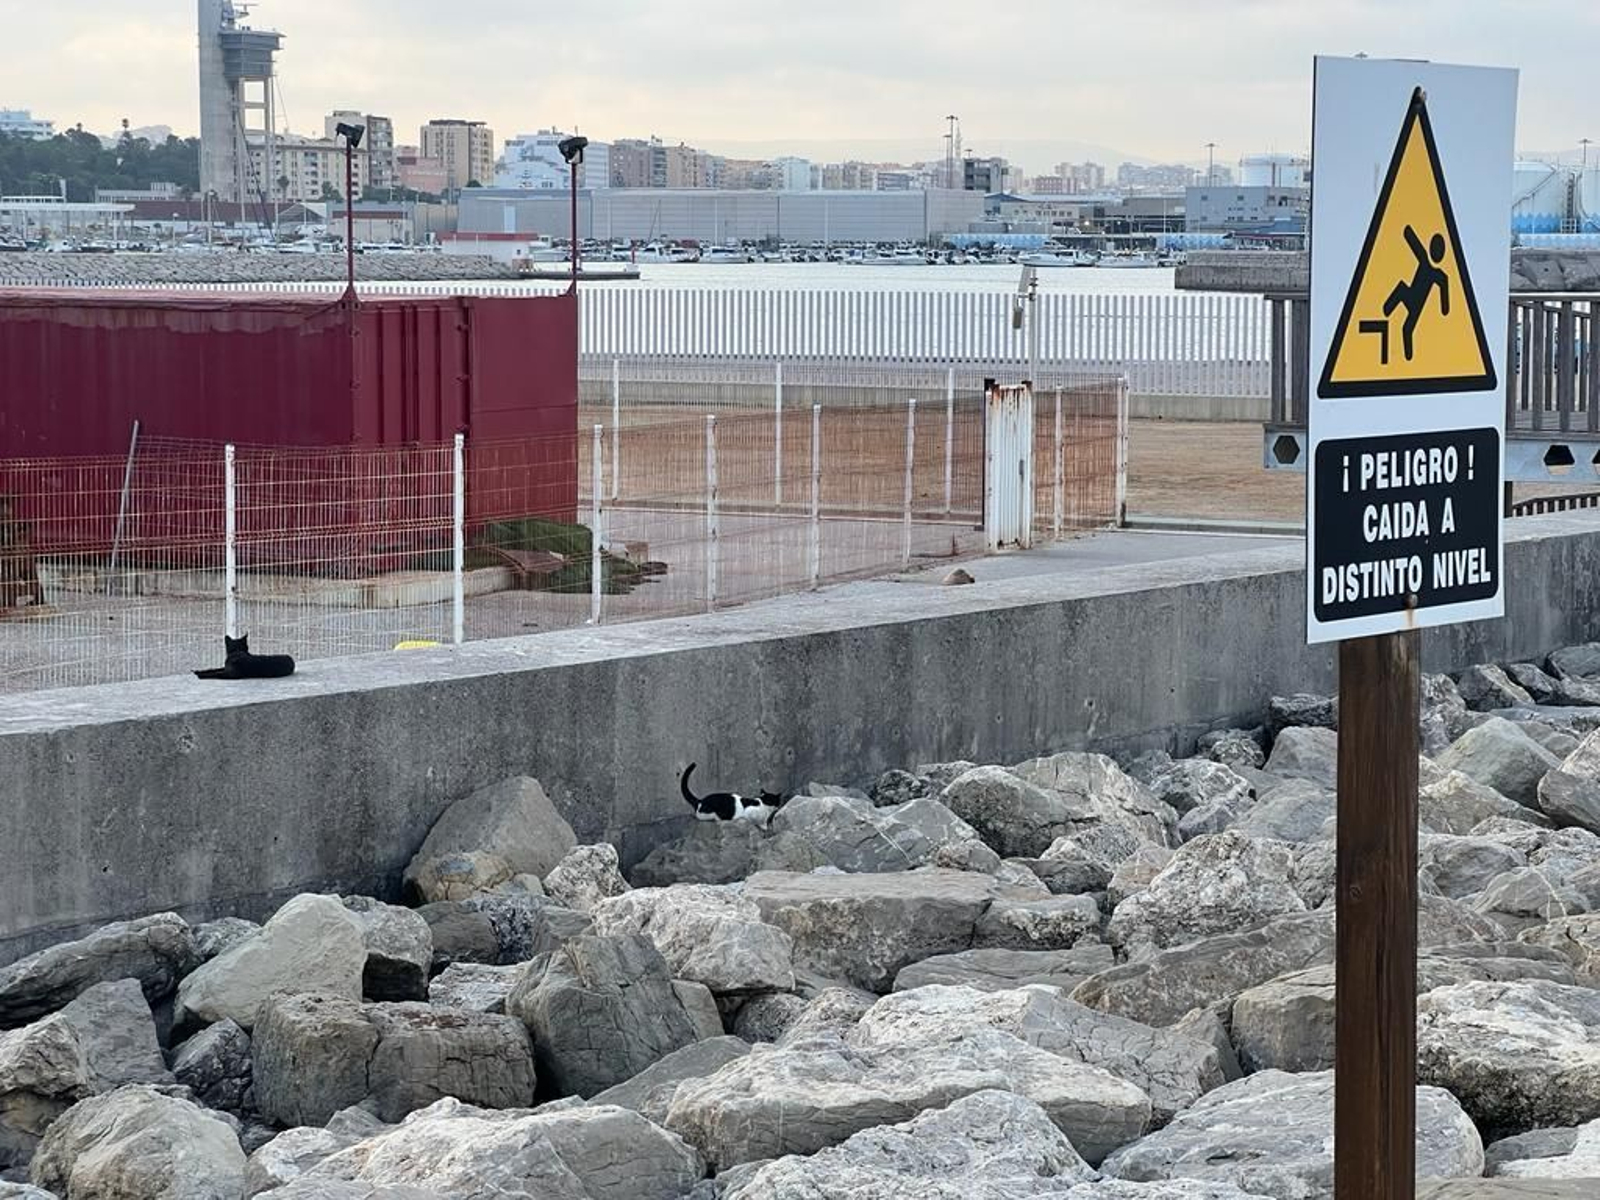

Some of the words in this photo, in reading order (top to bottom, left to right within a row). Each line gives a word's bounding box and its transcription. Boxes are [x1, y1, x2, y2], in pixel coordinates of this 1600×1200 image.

[1361, 446, 1458, 490] PELIGRO
[1363, 500, 1429, 542] CAIDA
[1441, 497, 1455, 534] A
[1322, 555, 1422, 605] DISTINTO
[1433, 548, 1491, 589] NIVEL
